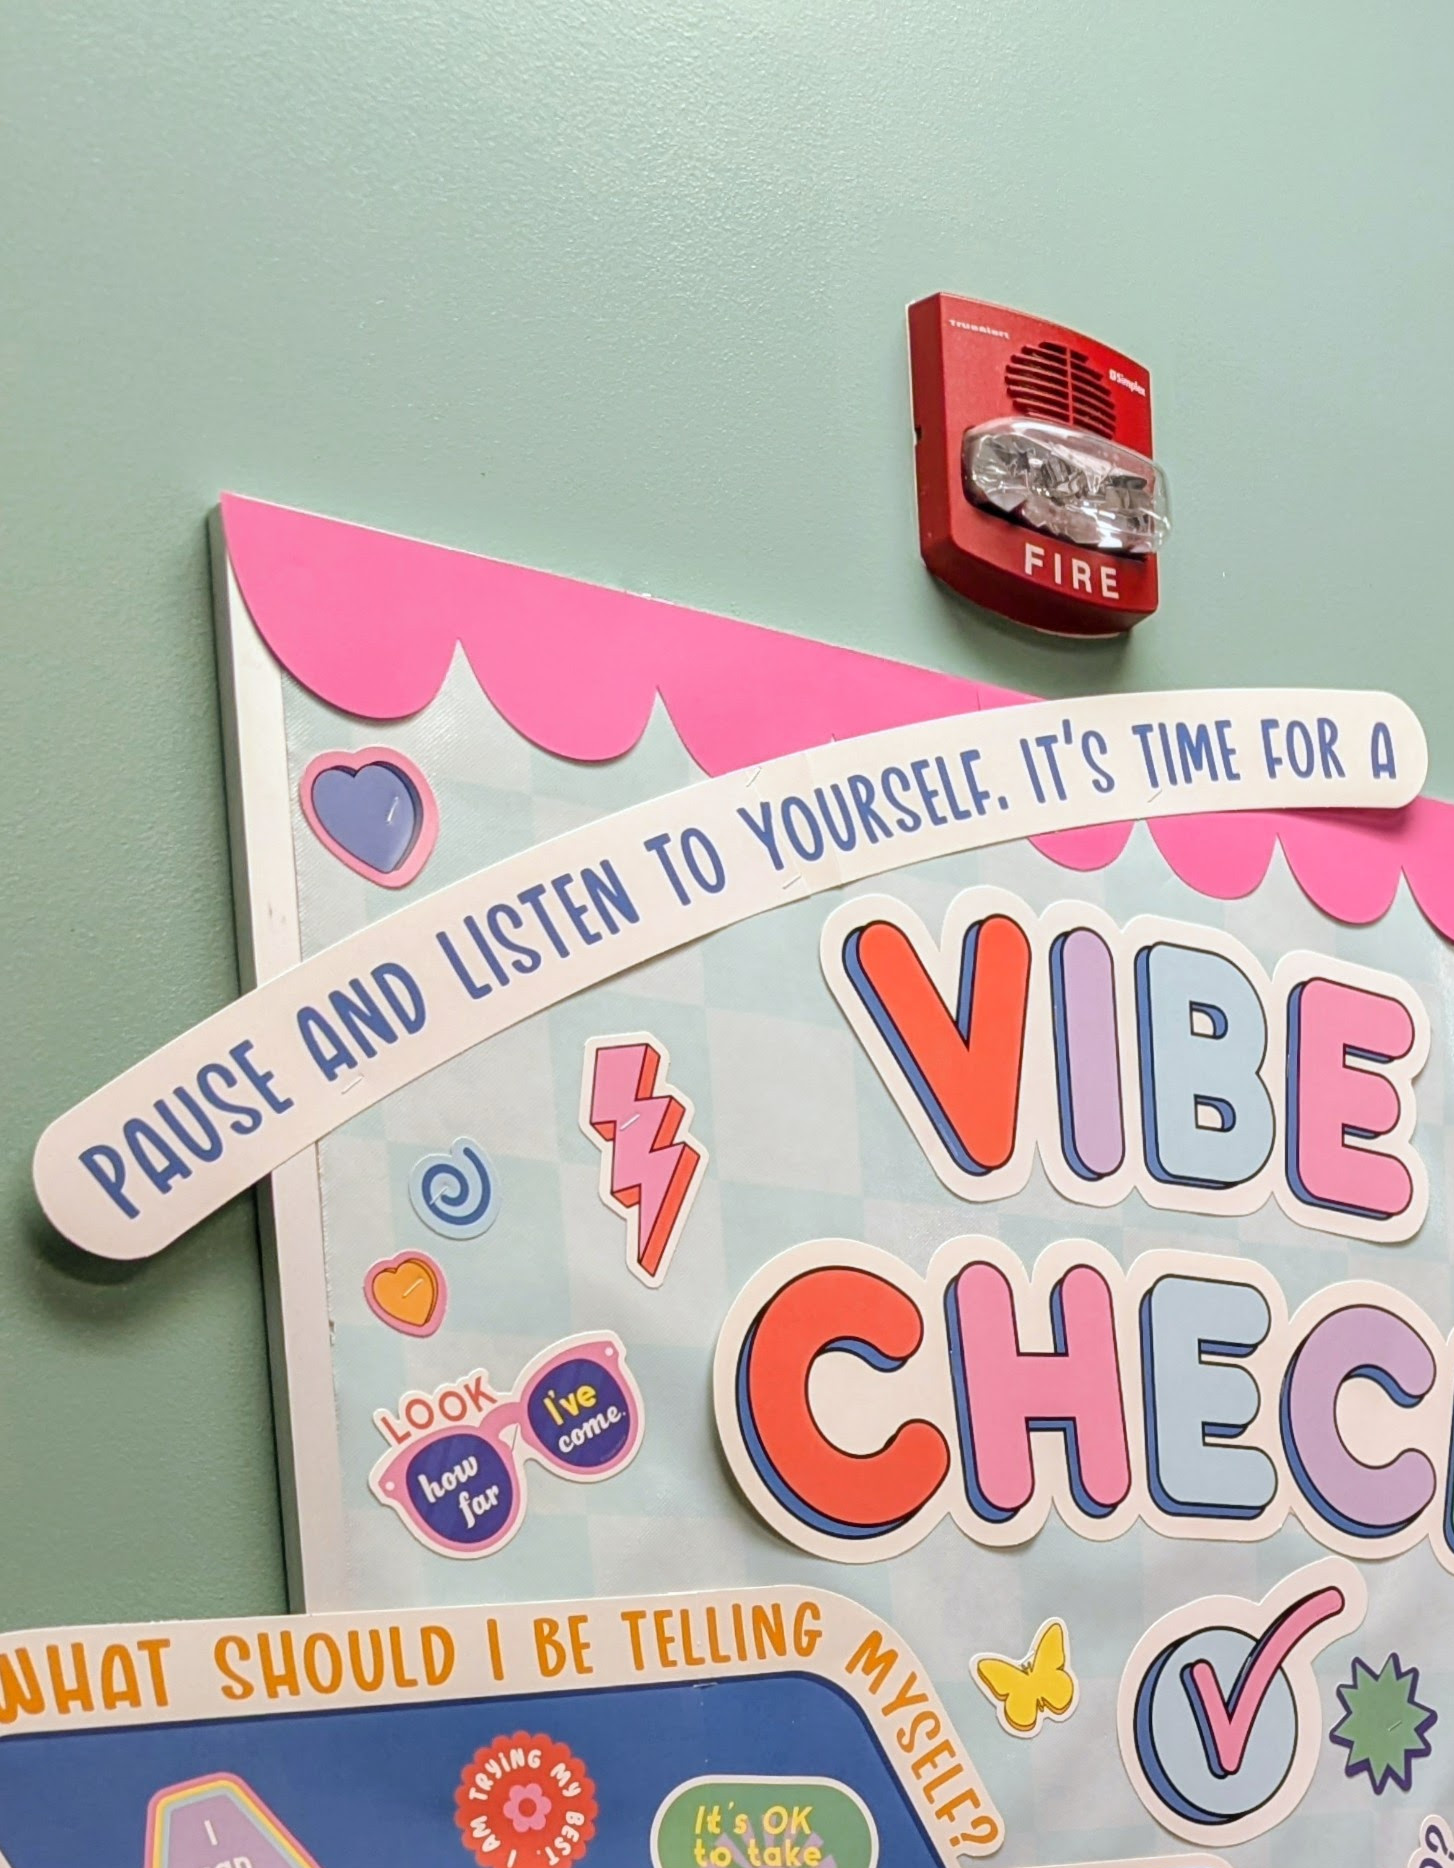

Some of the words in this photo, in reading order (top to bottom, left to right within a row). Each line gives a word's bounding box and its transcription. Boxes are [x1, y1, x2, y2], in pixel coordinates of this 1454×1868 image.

[1024, 542, 1120, 600] FIRE
[79, 1039, 294, 1219] PAUSE
[296, 962, 427, 1082] AND
[435, 859, 641, 1000] LISTEN
[643, 827, 727, 905] TO
[736, 748, 1011, 871] YOURSELF.
[1019, 719, 1116, 804] IT'S
[1131, 719, 1241, 789] TIME
[1259, 716, 1347, 782] FOR
[1370, 721, 1397, 781] A
[842, 914, 1415, 1221] VIBE
[381, 1375, 498, 1445] LOOK
[543, 1385, 597, 1426] I've
[558, 1405, 626, 1453] come.
[417, 1456, 479, 1503] how
[458, 1484, 500, 1529] far
[0, 1638, 171, 1724] WHAT
[213, 1624, 455, 1701] SHOULD
[485, 1618, 504, 1681] I
[533, 1615, 594, 1678] BE
[621, 1601, 823, 1671] TELLING
[845, 1629, 1000, 1848] MYSELF?
[204, 1819, 218, 1846] I
[470, 1815, 501, 1853] AM
[694, 1801, 749, 1835] It's
[763, 1805, 813, 1835] OK
[694, 1838, 733, 1868] to
[748, 1837, 822, 1868] take
